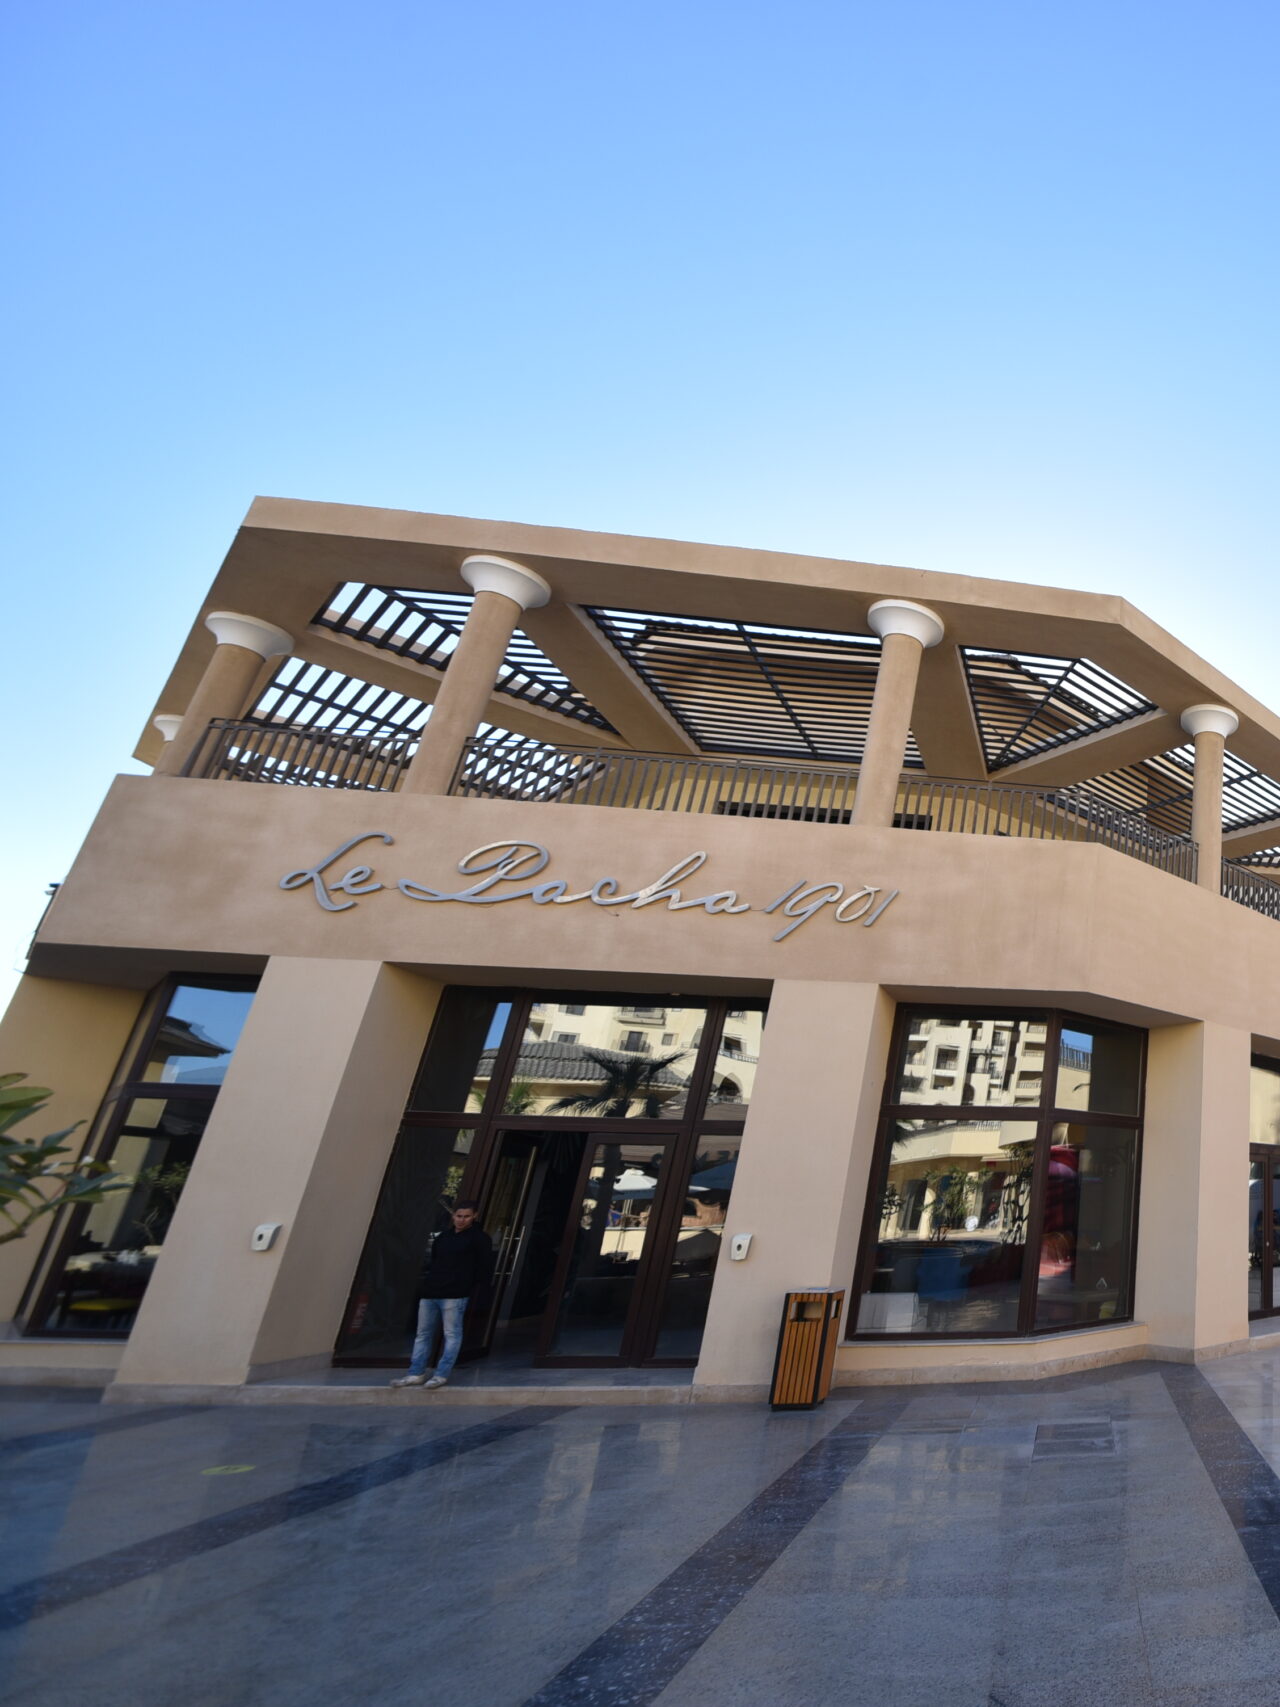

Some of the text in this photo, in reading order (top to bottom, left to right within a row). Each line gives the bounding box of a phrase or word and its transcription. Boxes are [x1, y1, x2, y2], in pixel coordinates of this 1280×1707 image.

[279, 831, 899, 942] Le Pacha 1901
